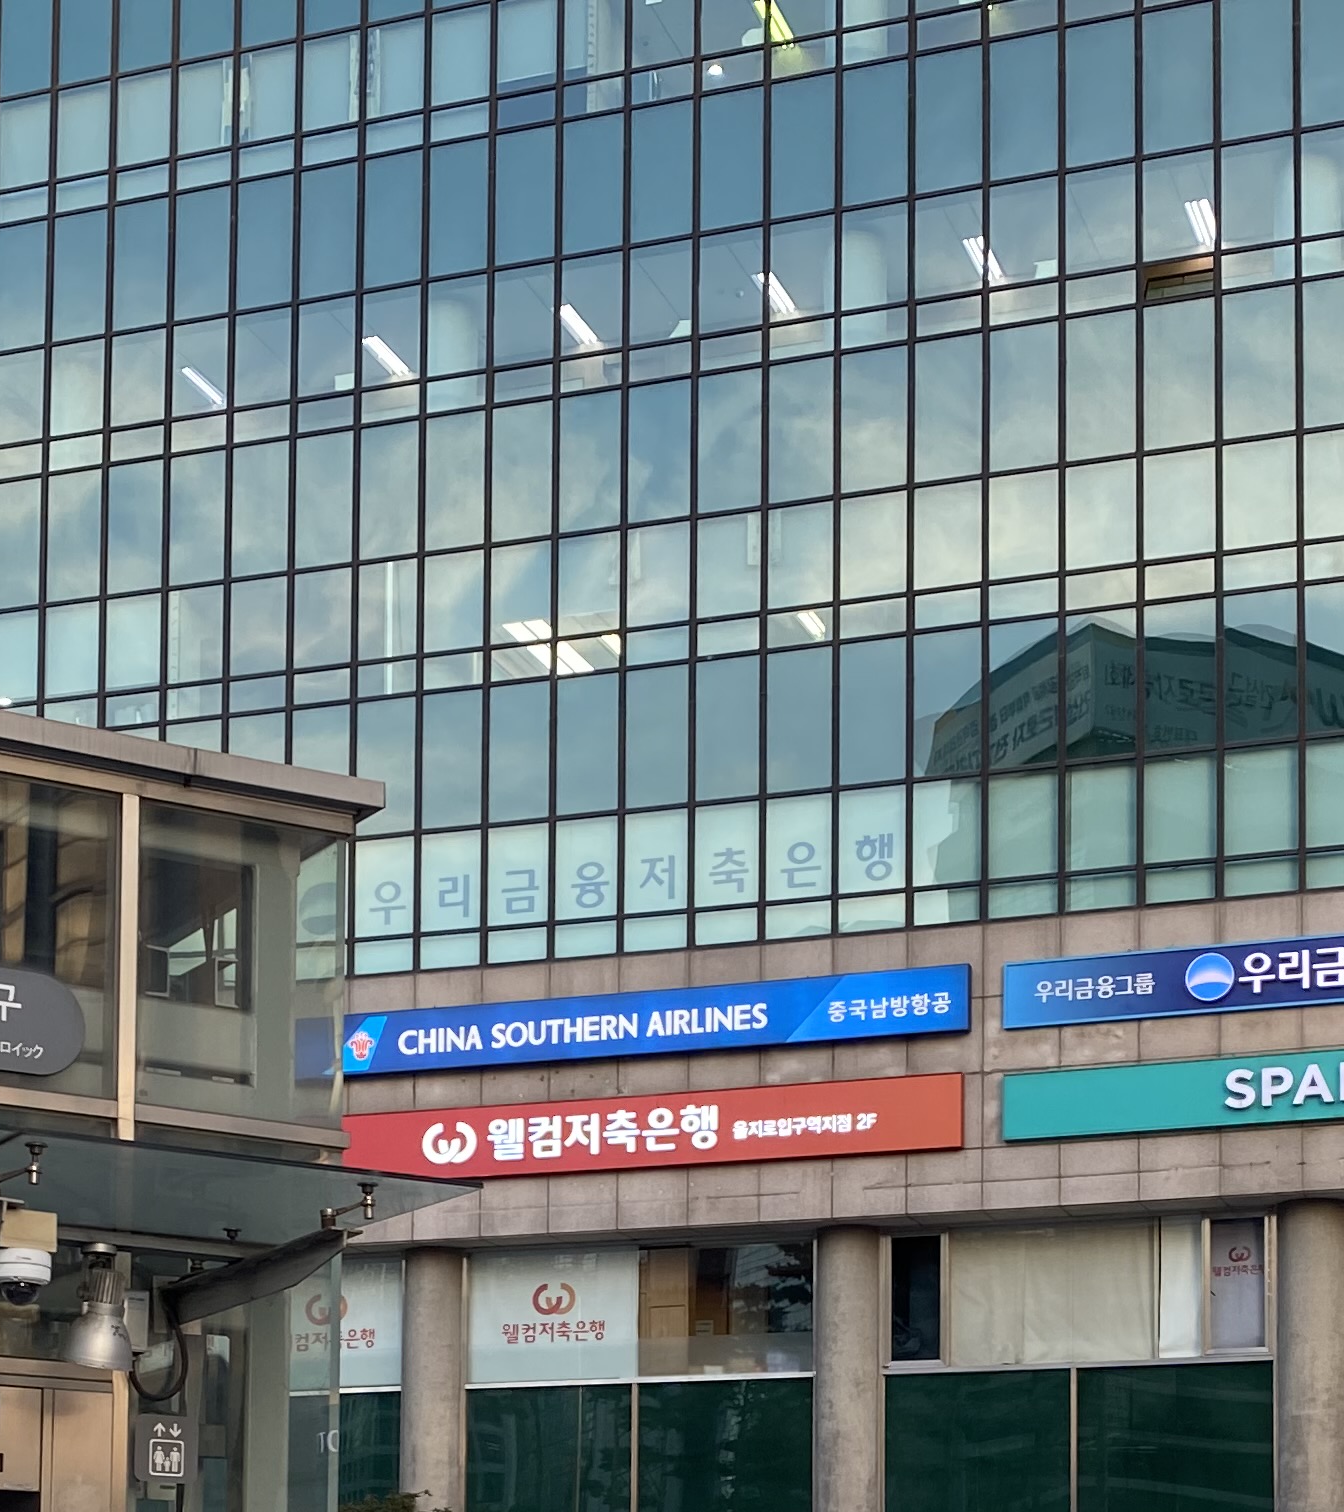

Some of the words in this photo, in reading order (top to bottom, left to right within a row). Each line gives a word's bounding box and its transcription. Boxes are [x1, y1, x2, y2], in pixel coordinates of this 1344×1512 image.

[368, 832, 895, 926] 우리금융저축은행
[1033, 970, 1155, 1004] 우리금융그룹
[827, 990, 953, 1024] 중국남방항공
[397, 1024, 483, 1056] CHINA
[491, 1012, 639, 1050] SOUTHERN
[646, 1002, 768, 1038] AIRLINES
[487, 1103, 720, 1161] 웰컴저축은행
[732, 1112, 852, 1140] 을지로입구역지점
[856, 1111, 878, 1132] 2F
[293, 1327, 376, 1352] 컴저은행
[501, 1319, 606, 1345] 웰컴저축은행
